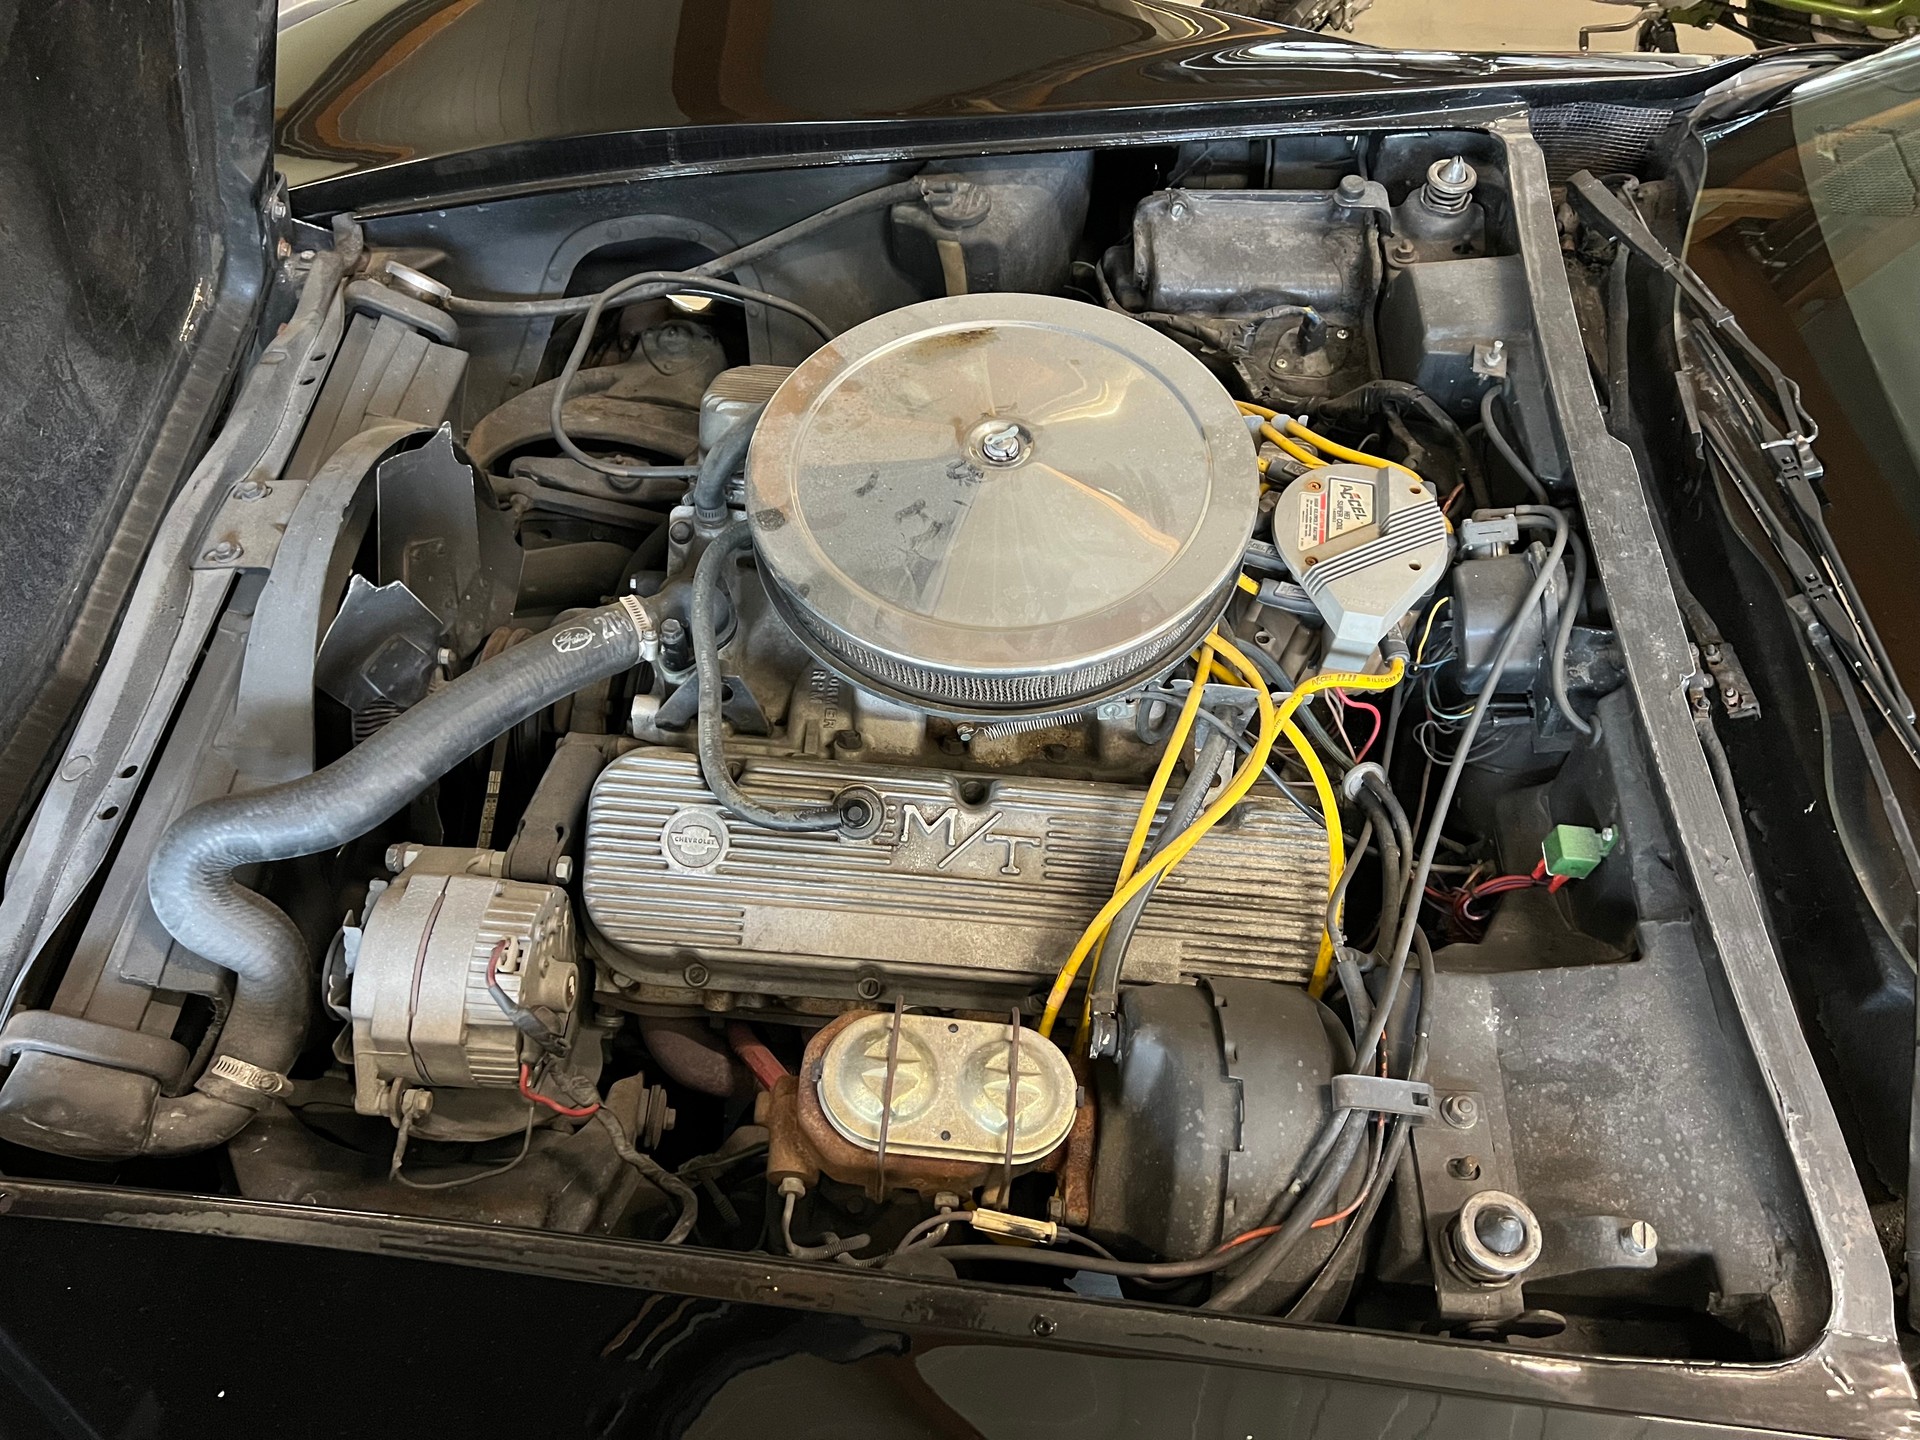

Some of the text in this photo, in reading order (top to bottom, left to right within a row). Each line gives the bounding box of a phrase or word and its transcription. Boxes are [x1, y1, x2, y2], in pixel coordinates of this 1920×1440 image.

[1339, 484, 1367, 521] ACCEL
[809, 670, 827, 704] RPM
[1182, 797, 1202, 829] PARKER
[674, 836, 715, 845] CHEVROLET
[898, 803, 1043, 876] M/T
